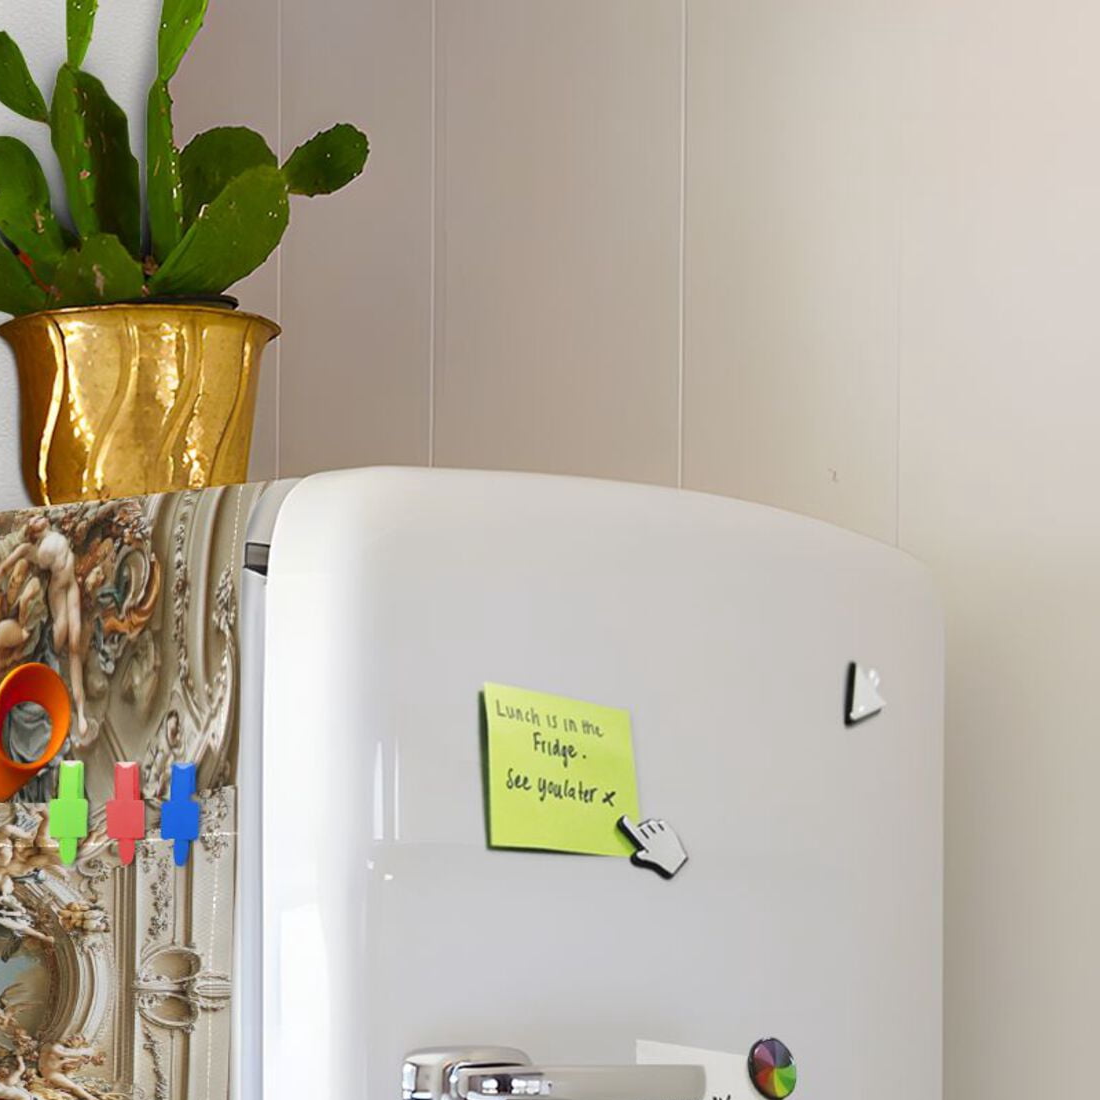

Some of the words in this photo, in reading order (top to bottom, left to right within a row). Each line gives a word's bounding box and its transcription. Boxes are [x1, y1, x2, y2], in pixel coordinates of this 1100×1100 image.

[496, 700, 541, 727] Lunch
[563, 717, 579, 733] in
[582, 720, 605, 738] the
[506, 767, 532, 791] See
